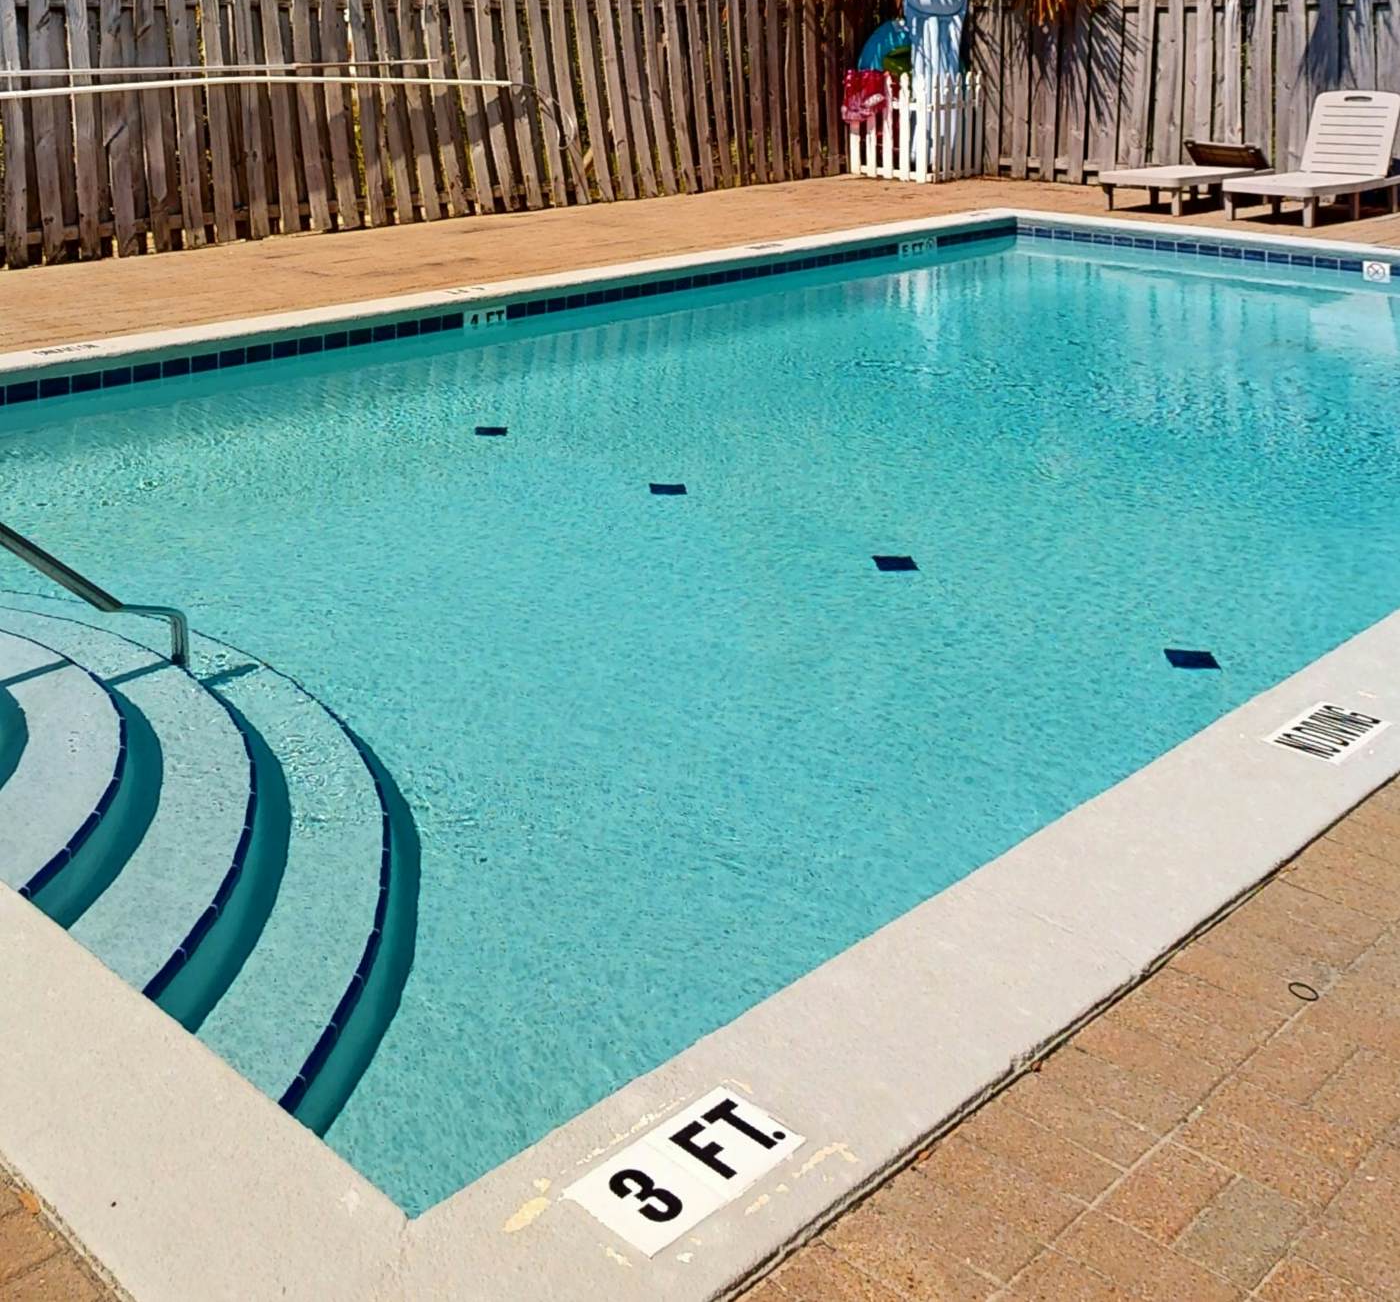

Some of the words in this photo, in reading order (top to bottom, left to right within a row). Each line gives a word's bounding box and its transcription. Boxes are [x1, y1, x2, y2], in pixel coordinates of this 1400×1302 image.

[470, 313, 479, 327] 4
[485, 309, 505, 325] FT
[1291, 704, 1382, 747] DIVING
[1273, 732, 1342, 760] NO
[608, 1168, 684, 1223] 3
[668, 1097, 786, 1181] FT.
